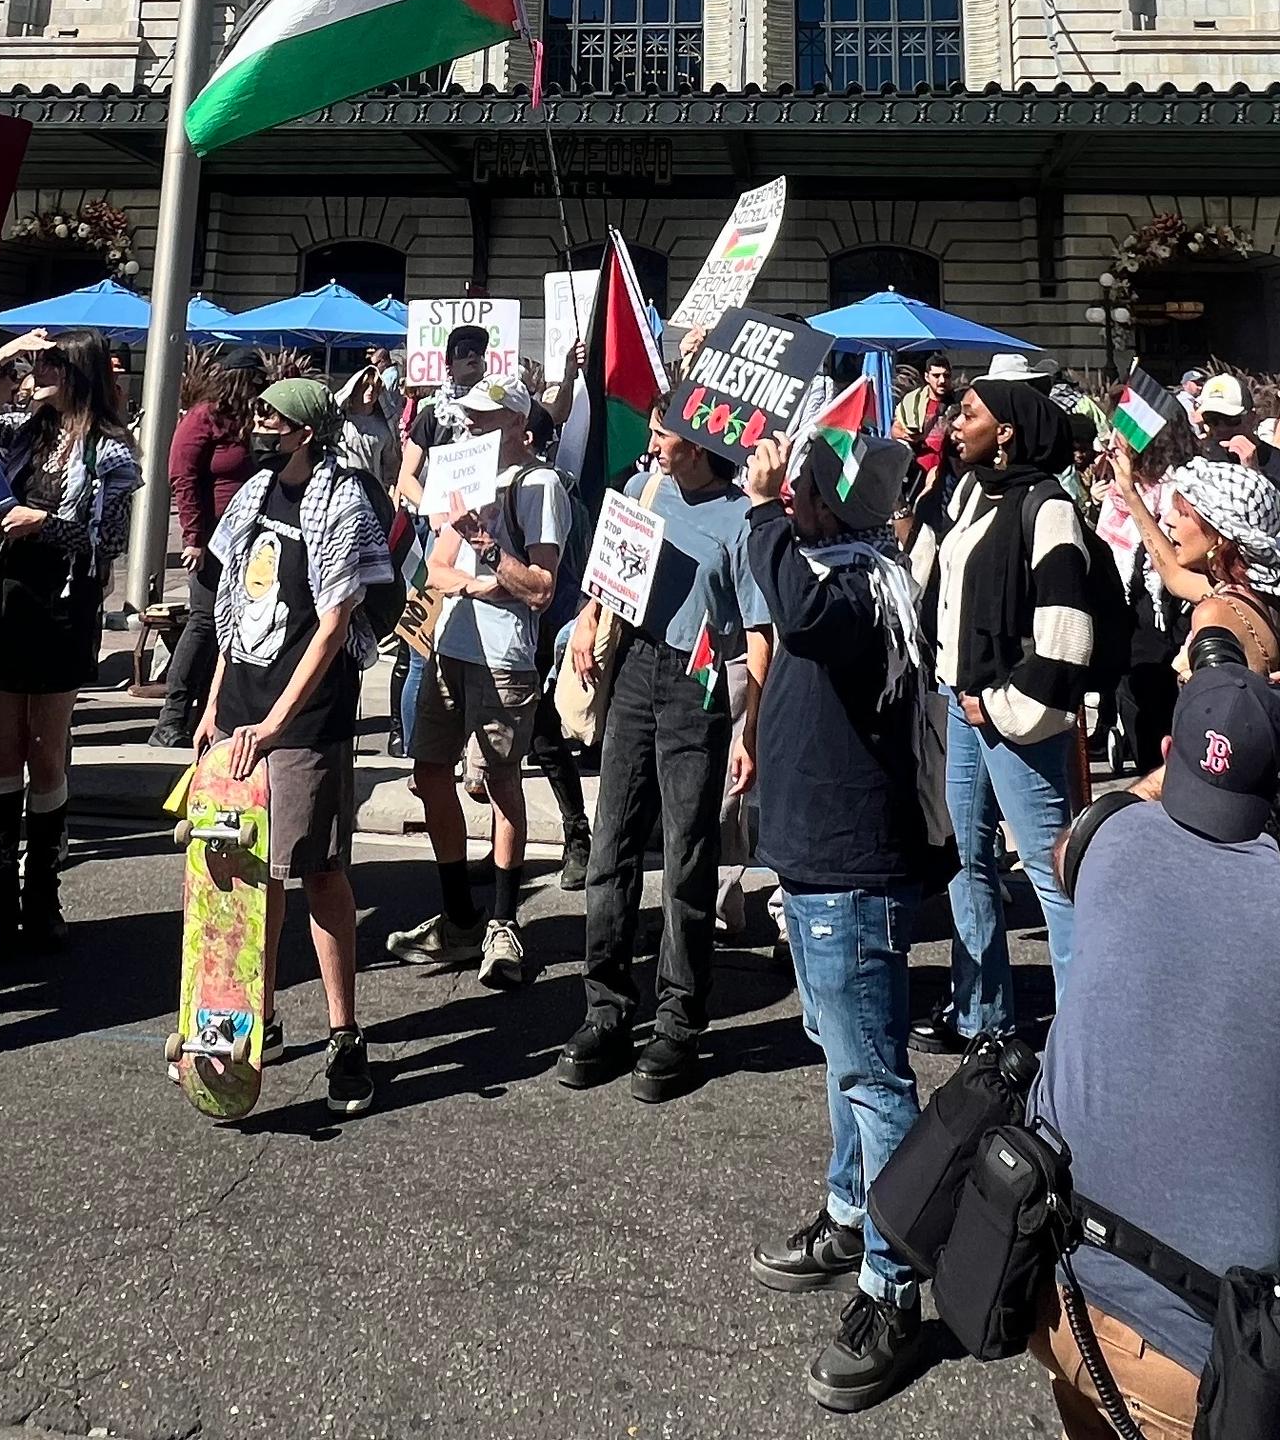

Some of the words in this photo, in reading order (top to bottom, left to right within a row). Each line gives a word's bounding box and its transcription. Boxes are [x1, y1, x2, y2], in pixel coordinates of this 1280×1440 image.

[473, 136, 673, 185] CRAWFORD
[429, 301, 494, 326] STOP
[730, 319, 795, 368] FREE
[689, 347, 805, 419] PALESTINE
[437, 442, 493, 465] PALESTINIAN
[452, 465, 476, 480] LIVES
[604, 519, 622, 536] STOP
[608, 506, 616, 517] TO
[616, 511, 654, 539] PHILIPPINES
[610, 497, 626, 512] FROM
[625, 506, 657, 529] PALESTINE
[603, 535, 617, 551] THE
[592, 568, 608, 584] WAR
[606, 579, 640, 603] MACHINE!
[1199, 729, 1233, 775] B
